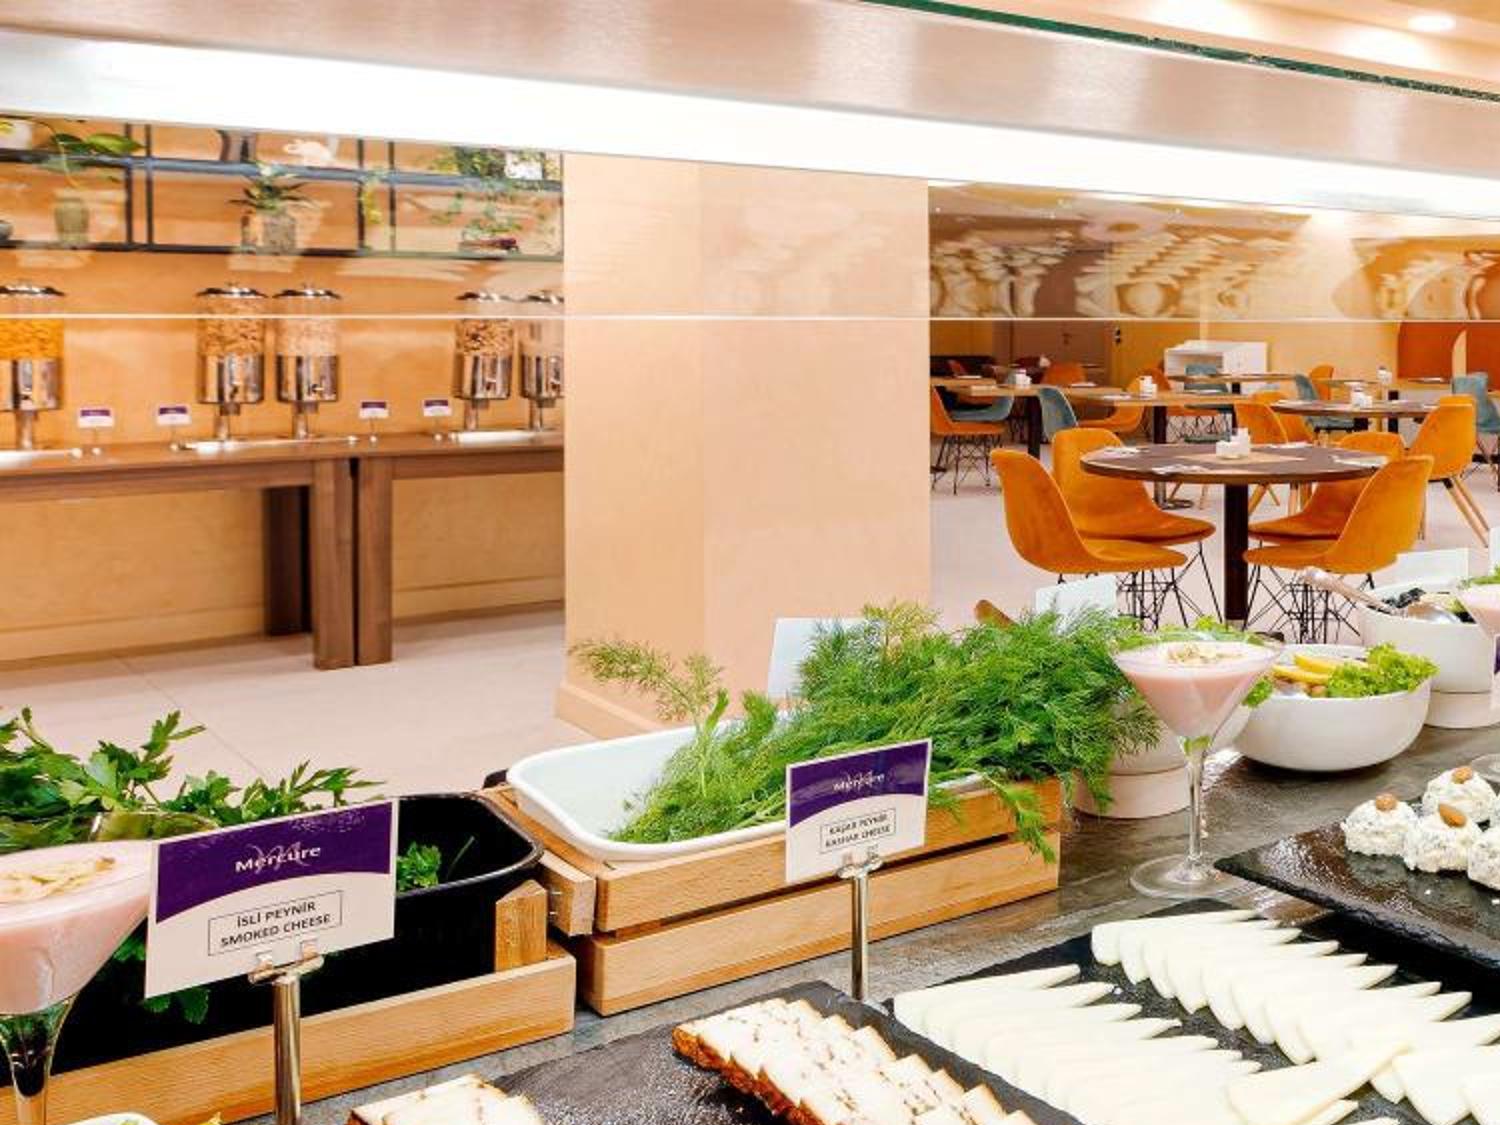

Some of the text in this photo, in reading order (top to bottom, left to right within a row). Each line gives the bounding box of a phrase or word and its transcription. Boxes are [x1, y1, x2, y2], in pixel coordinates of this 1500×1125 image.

[235, 845, 321, 873] Mercure
[237, 901, 316, 928] İSLİ PEYNİR
[221, 913, 331, 947] SMOKED CHEESE
